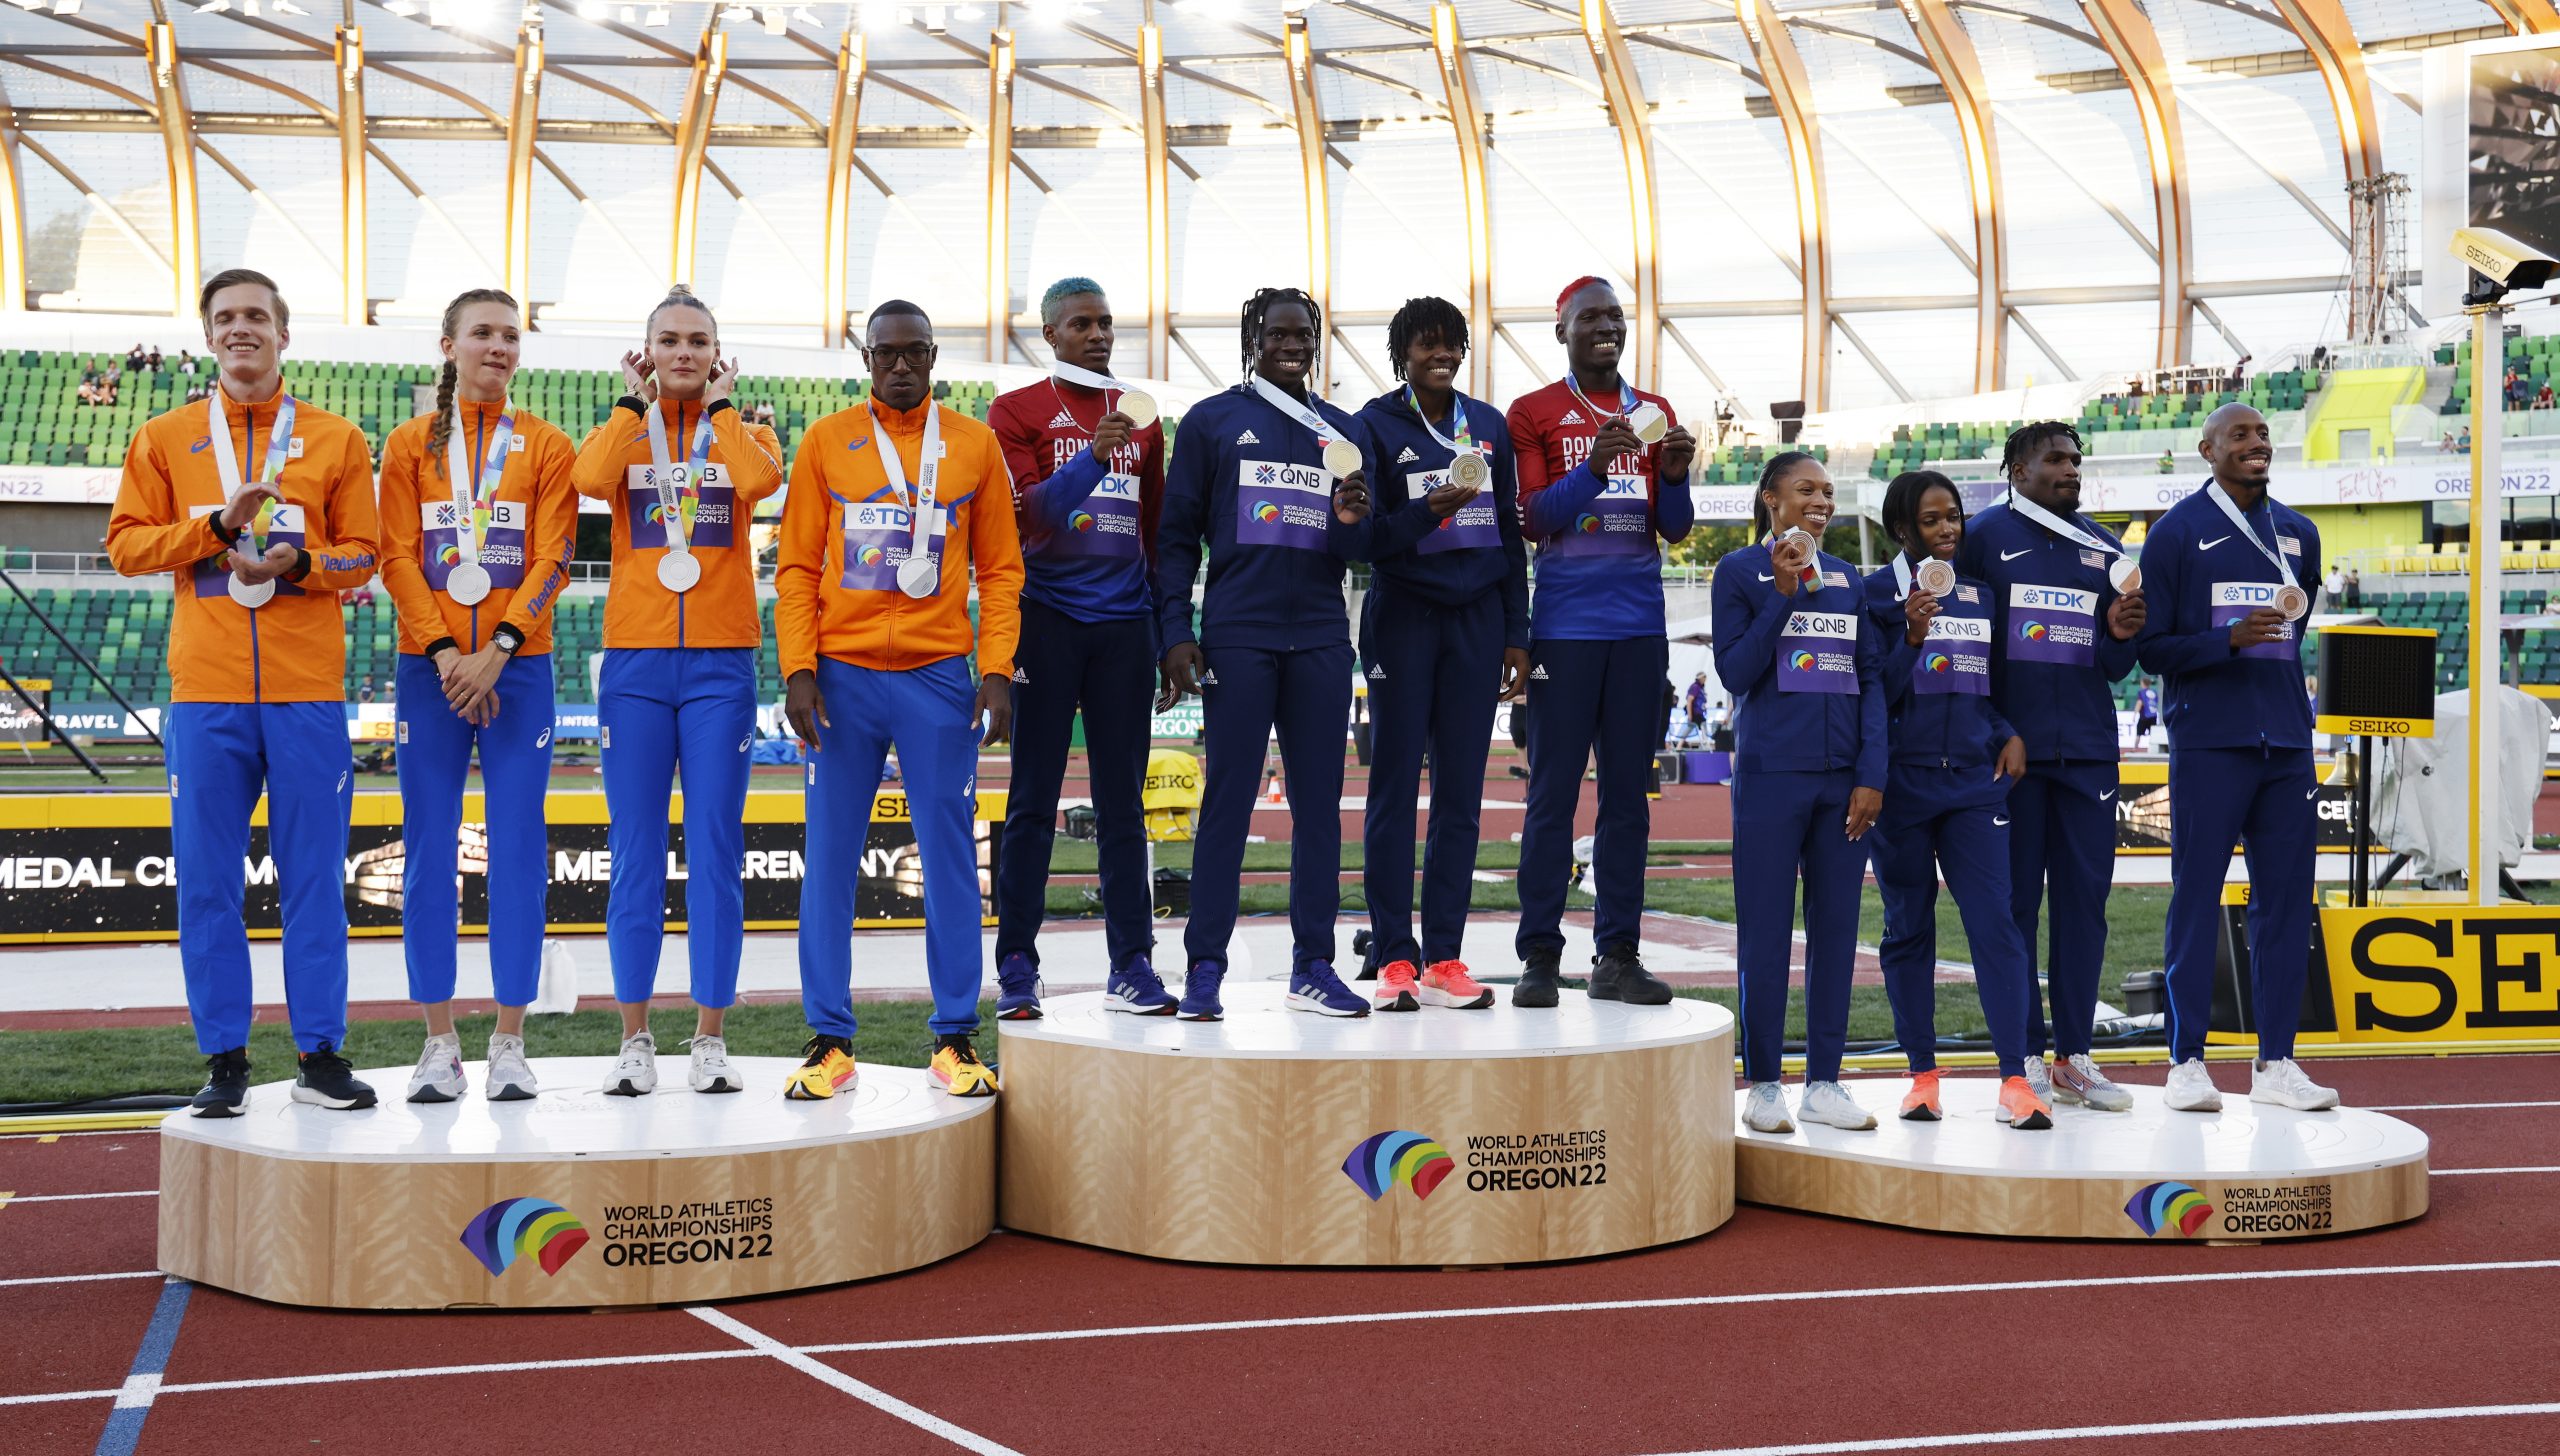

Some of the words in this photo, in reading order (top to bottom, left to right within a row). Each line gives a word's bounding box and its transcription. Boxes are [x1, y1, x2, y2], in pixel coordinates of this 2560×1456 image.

[2465, 245, 2502, 273] SEIKO
[1048, 420, 1076, 429] adidas
[1397, 455, 1420, 464] adidas
[1101, 476, 1129, 496] DK
[1280, 468, 1320, 489] QNB
[1605, 479, 1637, 494] DK
[695, 515, 730, 524] GON22
[876, 508, 916, 526] TD
[1116, 515, 1137, 523] ATHLETICS
[1283, 509, 1327, 522] CHAMPIONSHIPS
[1303, 507, 1327, 517] ATHLETICS
[1097, 518, 1137, 528] CHAMPIONSHIPS
[491, 544, 522, 552] ATHLETICS
[886, 546, 908, 554] WORLD
[481, 556, 523, 566] EGON22
[2039, 589, 2084, 609] TDK
[1812, 617, 1847, 634] QNB
[1945, 621, 1981, 636] QNB
[2069, 626, 2093, 634] ATHLETICS
[2049, 629, 2093, 639] CHAMPIONSHIPS
[1817, 657, 1853, 666] CHAMPIONSHIPS
[1952, 658, 1987, 668] CHAMPIONSHIPS
[2349, 719, 2410, 734] SEIKO
[1145, 774, 1195, 789] EIKO
[1467, 1135, 1527, 1150] WORLD
[1531, 1130, 1606, 1148] ATHLETICS
[1467, 1145, 1606, 1167] CHAMPIONSHIPS
[1466, 1163, 1607, 1192] OREGON22
[2224, 1188, 2270, 1199] WORLD
[2274, 1184, 2332, 1198] ATHLETICS
[604, 1205, 673, 1222] WORLD
[678, 1197, 773, 1219] ATHLETICS
[2224, 1197, 2332, 1213] CHAMPIONSHIPS
[604, 1214, 773, 1240] CHAMPIONSHIPS
[2223, 1211, 2332, 1233] OREGON22
[602, 1234, 773, 1267] OREGON22
